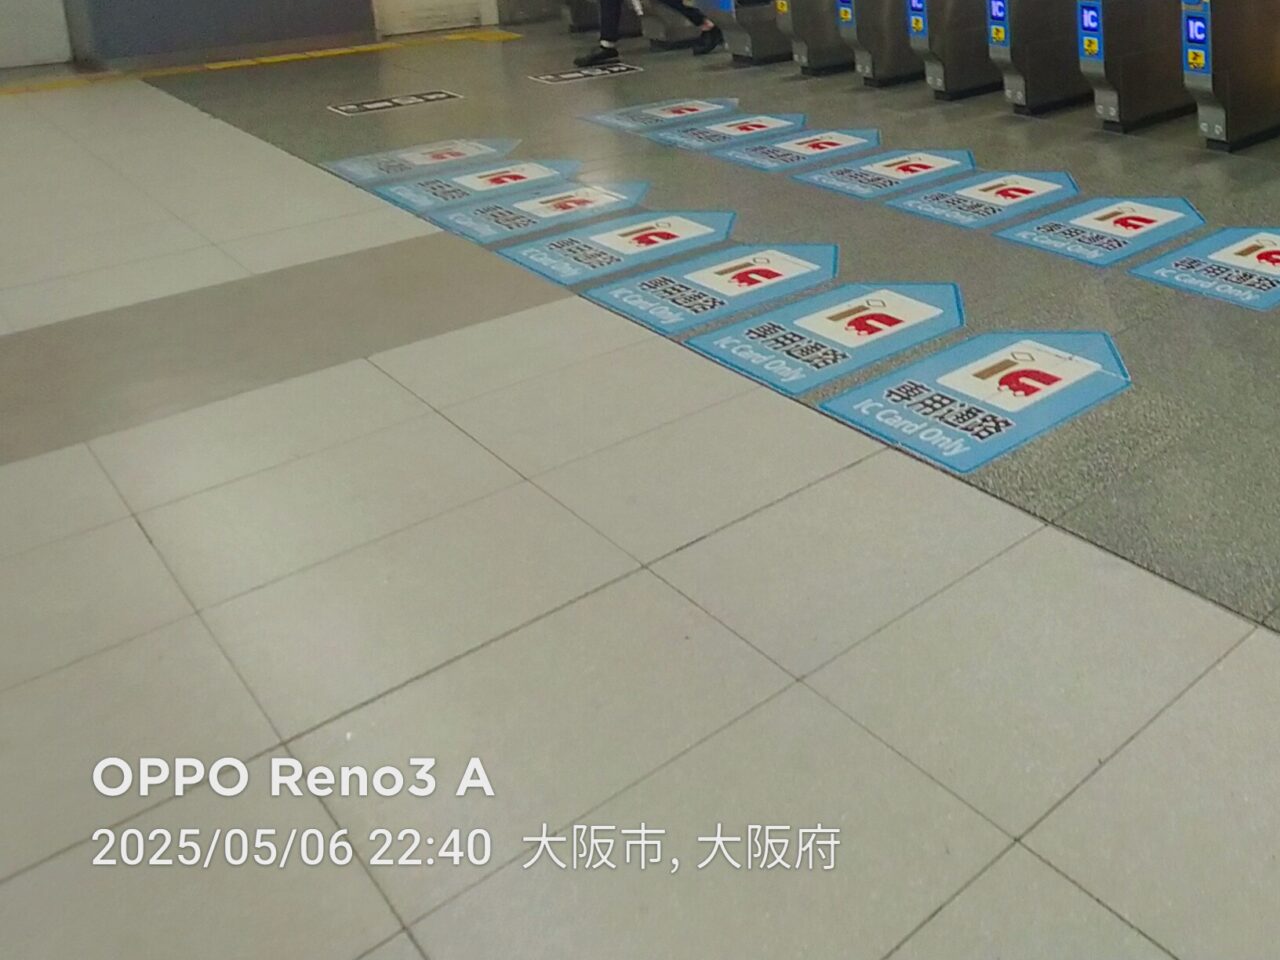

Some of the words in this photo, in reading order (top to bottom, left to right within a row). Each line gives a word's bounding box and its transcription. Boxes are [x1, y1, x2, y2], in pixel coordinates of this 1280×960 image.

[991, 0, 1005, 18] IC
[1082, 9, 1099, 29] IC
[1188, 20, 1206, 41] IC
[730, 344, 766, 365] Card
[763, 358, 807, 382] Only
[882, 377, 1017, 442] 専用通路
[853, 397, 876, 415] IC
[875, 408, 922, 436] Card
[918, 426, 971, 457] Only
